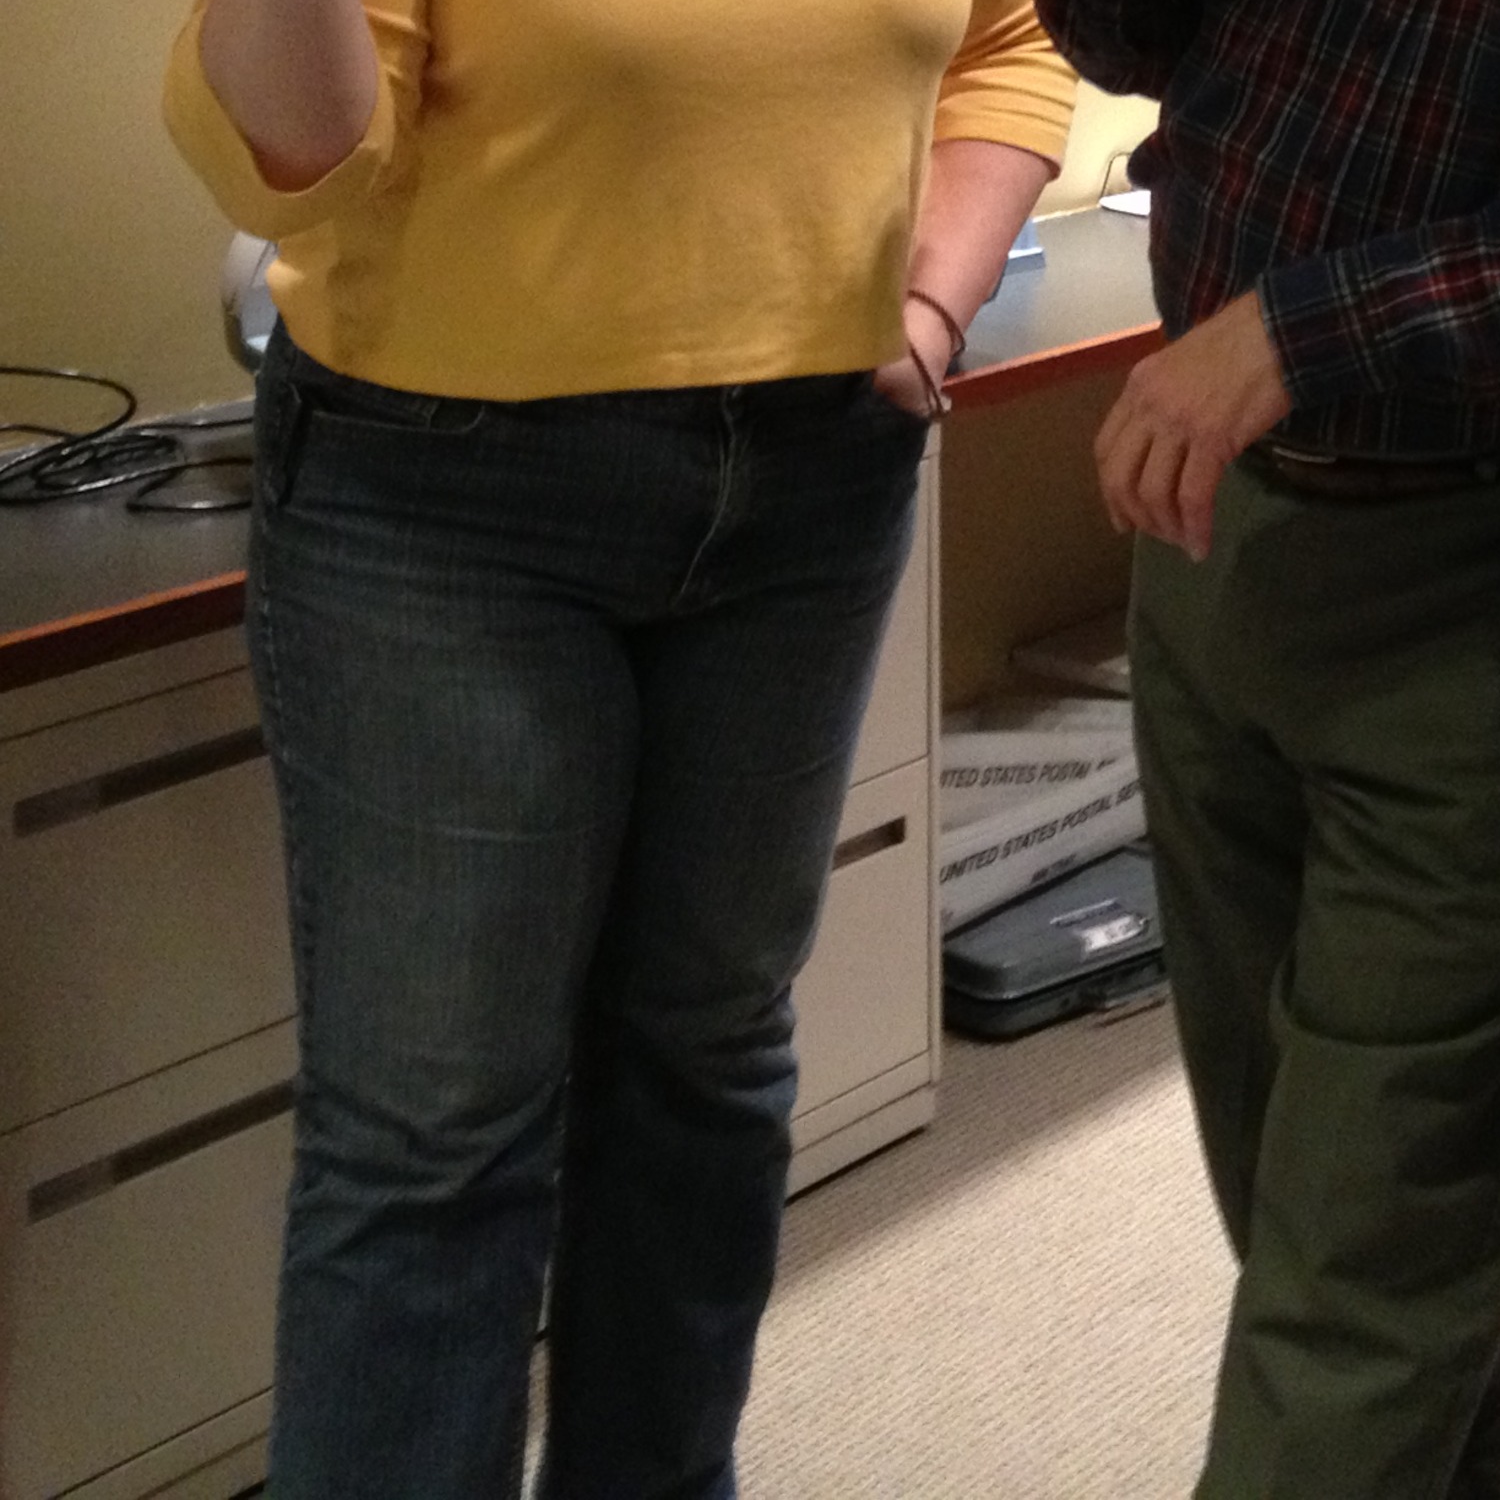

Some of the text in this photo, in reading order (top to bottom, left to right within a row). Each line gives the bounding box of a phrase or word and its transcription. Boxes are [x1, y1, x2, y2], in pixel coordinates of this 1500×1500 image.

[980, 763, 1037, 788] STATES
[939, 845, 999, 885] UNITED
[1000, 819, 1058, 860] STATES
[1060, 795, 1112, 833] POSTAL
